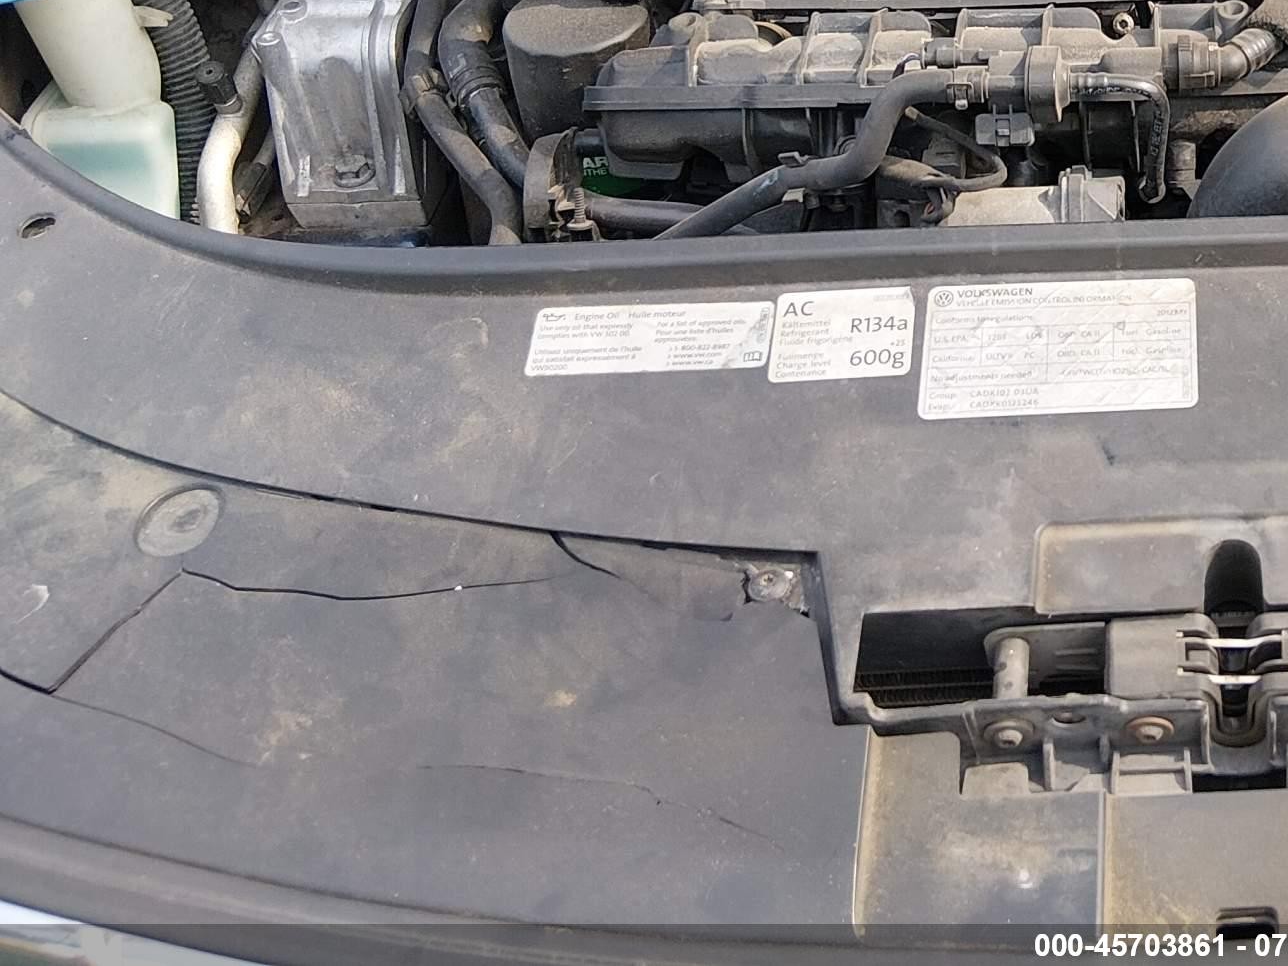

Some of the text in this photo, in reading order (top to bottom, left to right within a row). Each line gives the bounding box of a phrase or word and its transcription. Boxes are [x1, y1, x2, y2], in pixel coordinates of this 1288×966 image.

[957, 286, 1034, 299] VOLKSWAGEN
[991, 297, 1032, 306] EMISSION
[1033, 295, 1073, 305] CONTROL
[1074, 293, 1133, 304] INFORMATION
[574, 309, 687, 322] Engine Oil Huile moteur
[783, 300, 816, 319] AC
[850, 315, 909, 334] R134a
[1145, 326, 1182, 336] Gasoline
[780, 327, 830, 339] Refrigerant
[776, 359, 832, 372] Charge level
[849, 348, 905, 370] 600g
[775, 369, 827, 379] Contenance
